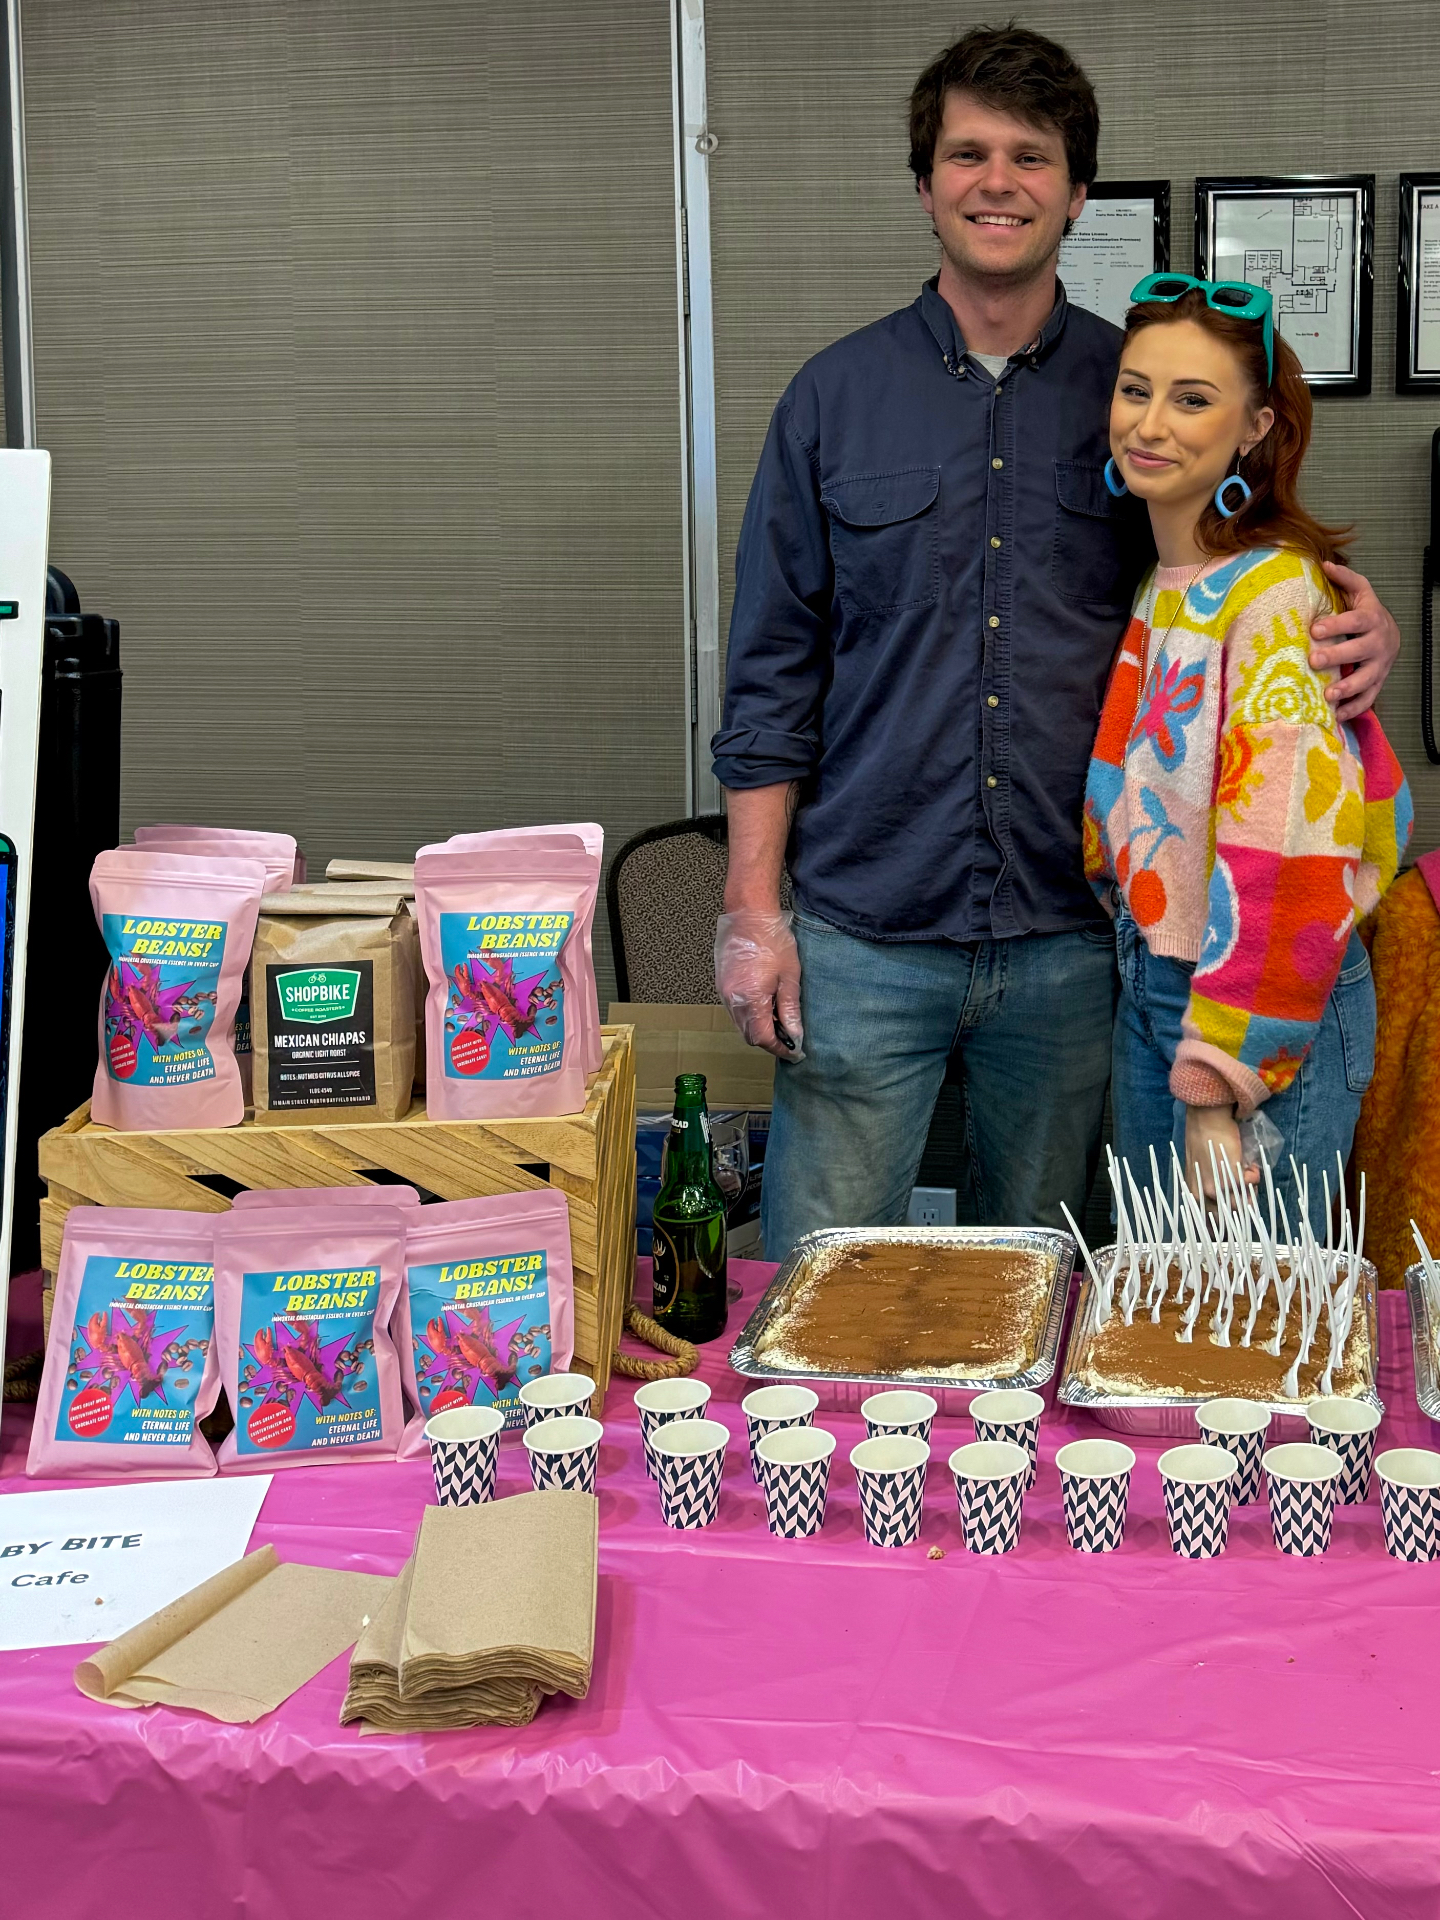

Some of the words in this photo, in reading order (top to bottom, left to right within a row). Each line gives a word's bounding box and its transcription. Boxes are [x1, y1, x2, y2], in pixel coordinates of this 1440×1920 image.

[122, 919, 223, 939] LOBSTER
[467, 915, 570, 931] LOBSTER
[131, 938, 212, 958] BEANS!
[480, 931, 561, 949] BEANS!
[285, 984, 350, 1003] SHOPBIKE
[274, 1034, 320, 1048] MEXICAN
[322, 1031, 366, 1046] CHIAPAS
[152, 1054, 171, 1063] WITH
[173, 1051, 195, 1061] NOTES
[292, 1050, 314, 1059] ORGANIC
[315, 1049, 329, 1058] LIGHT
[330, 1049, 346, 1057] ROAST
[508, 1047, 527, 1056] WITH
[529, 1043, 551, 1054] NOTES
[164, 1063, 195, 1073] ETERNAL
[198, 1057, 210, 1068] LIFE
[520, 1054, 547, 1066] ETERNAL
[549, 1051, 560, 1061] LIFE
[150, 1076, 164, 1084] AND
[166, 1072, 190, 1084] NEVER
[193, 1068, 214, 1080] DEATH
[503, 1068, 519, 1077] AND
[521, 1065, 542, 1076] NEVER
[544, 1061, 561, 1071] DEATH
[439, 1254, 543, 1283] LOBSTER
[272, 1271, 377, 1292] LOBSTER
[455, 1274, 536, 1300] BEANS!
[125, 1283, 209, 1301] BEANS!
[286, 1290, 368, 1312] BEANS!
[492, 1398, 511, 1409] WITH
[131, 1408, 151, 1418] WITH
[153, 1409, 177, 1419] NOTES
[178, 1410, 191, 1419] OF:
[315, 1415, 336, 1425] WITH
[338, 1411, 363, 1422] NOTES
[365, 1409, 376, 1418] OF:
[141, 1421, 173, 1430] ETERNAL
[175, 1422, 190, 1431] LIFE
[329, 1423, 361, 1434] ETERNAL
[363, 1419, 378, 1430] LIFE
[506, 1419, 525, 1428] NEVE
[123, 1433, 140, 1442] AND
[141, 1433, 165, 1442] NEVER
[167, 1434, 192, 1443] DEATH
[311, 1438, 328, 1447] AND
[330, 1434, 354, 1445] NEVER
[357, 1430, 380, 1441] DEATH
[60, 1534, 142, 1551] BITE
[11, 1571, 89, 1587] Cafe
